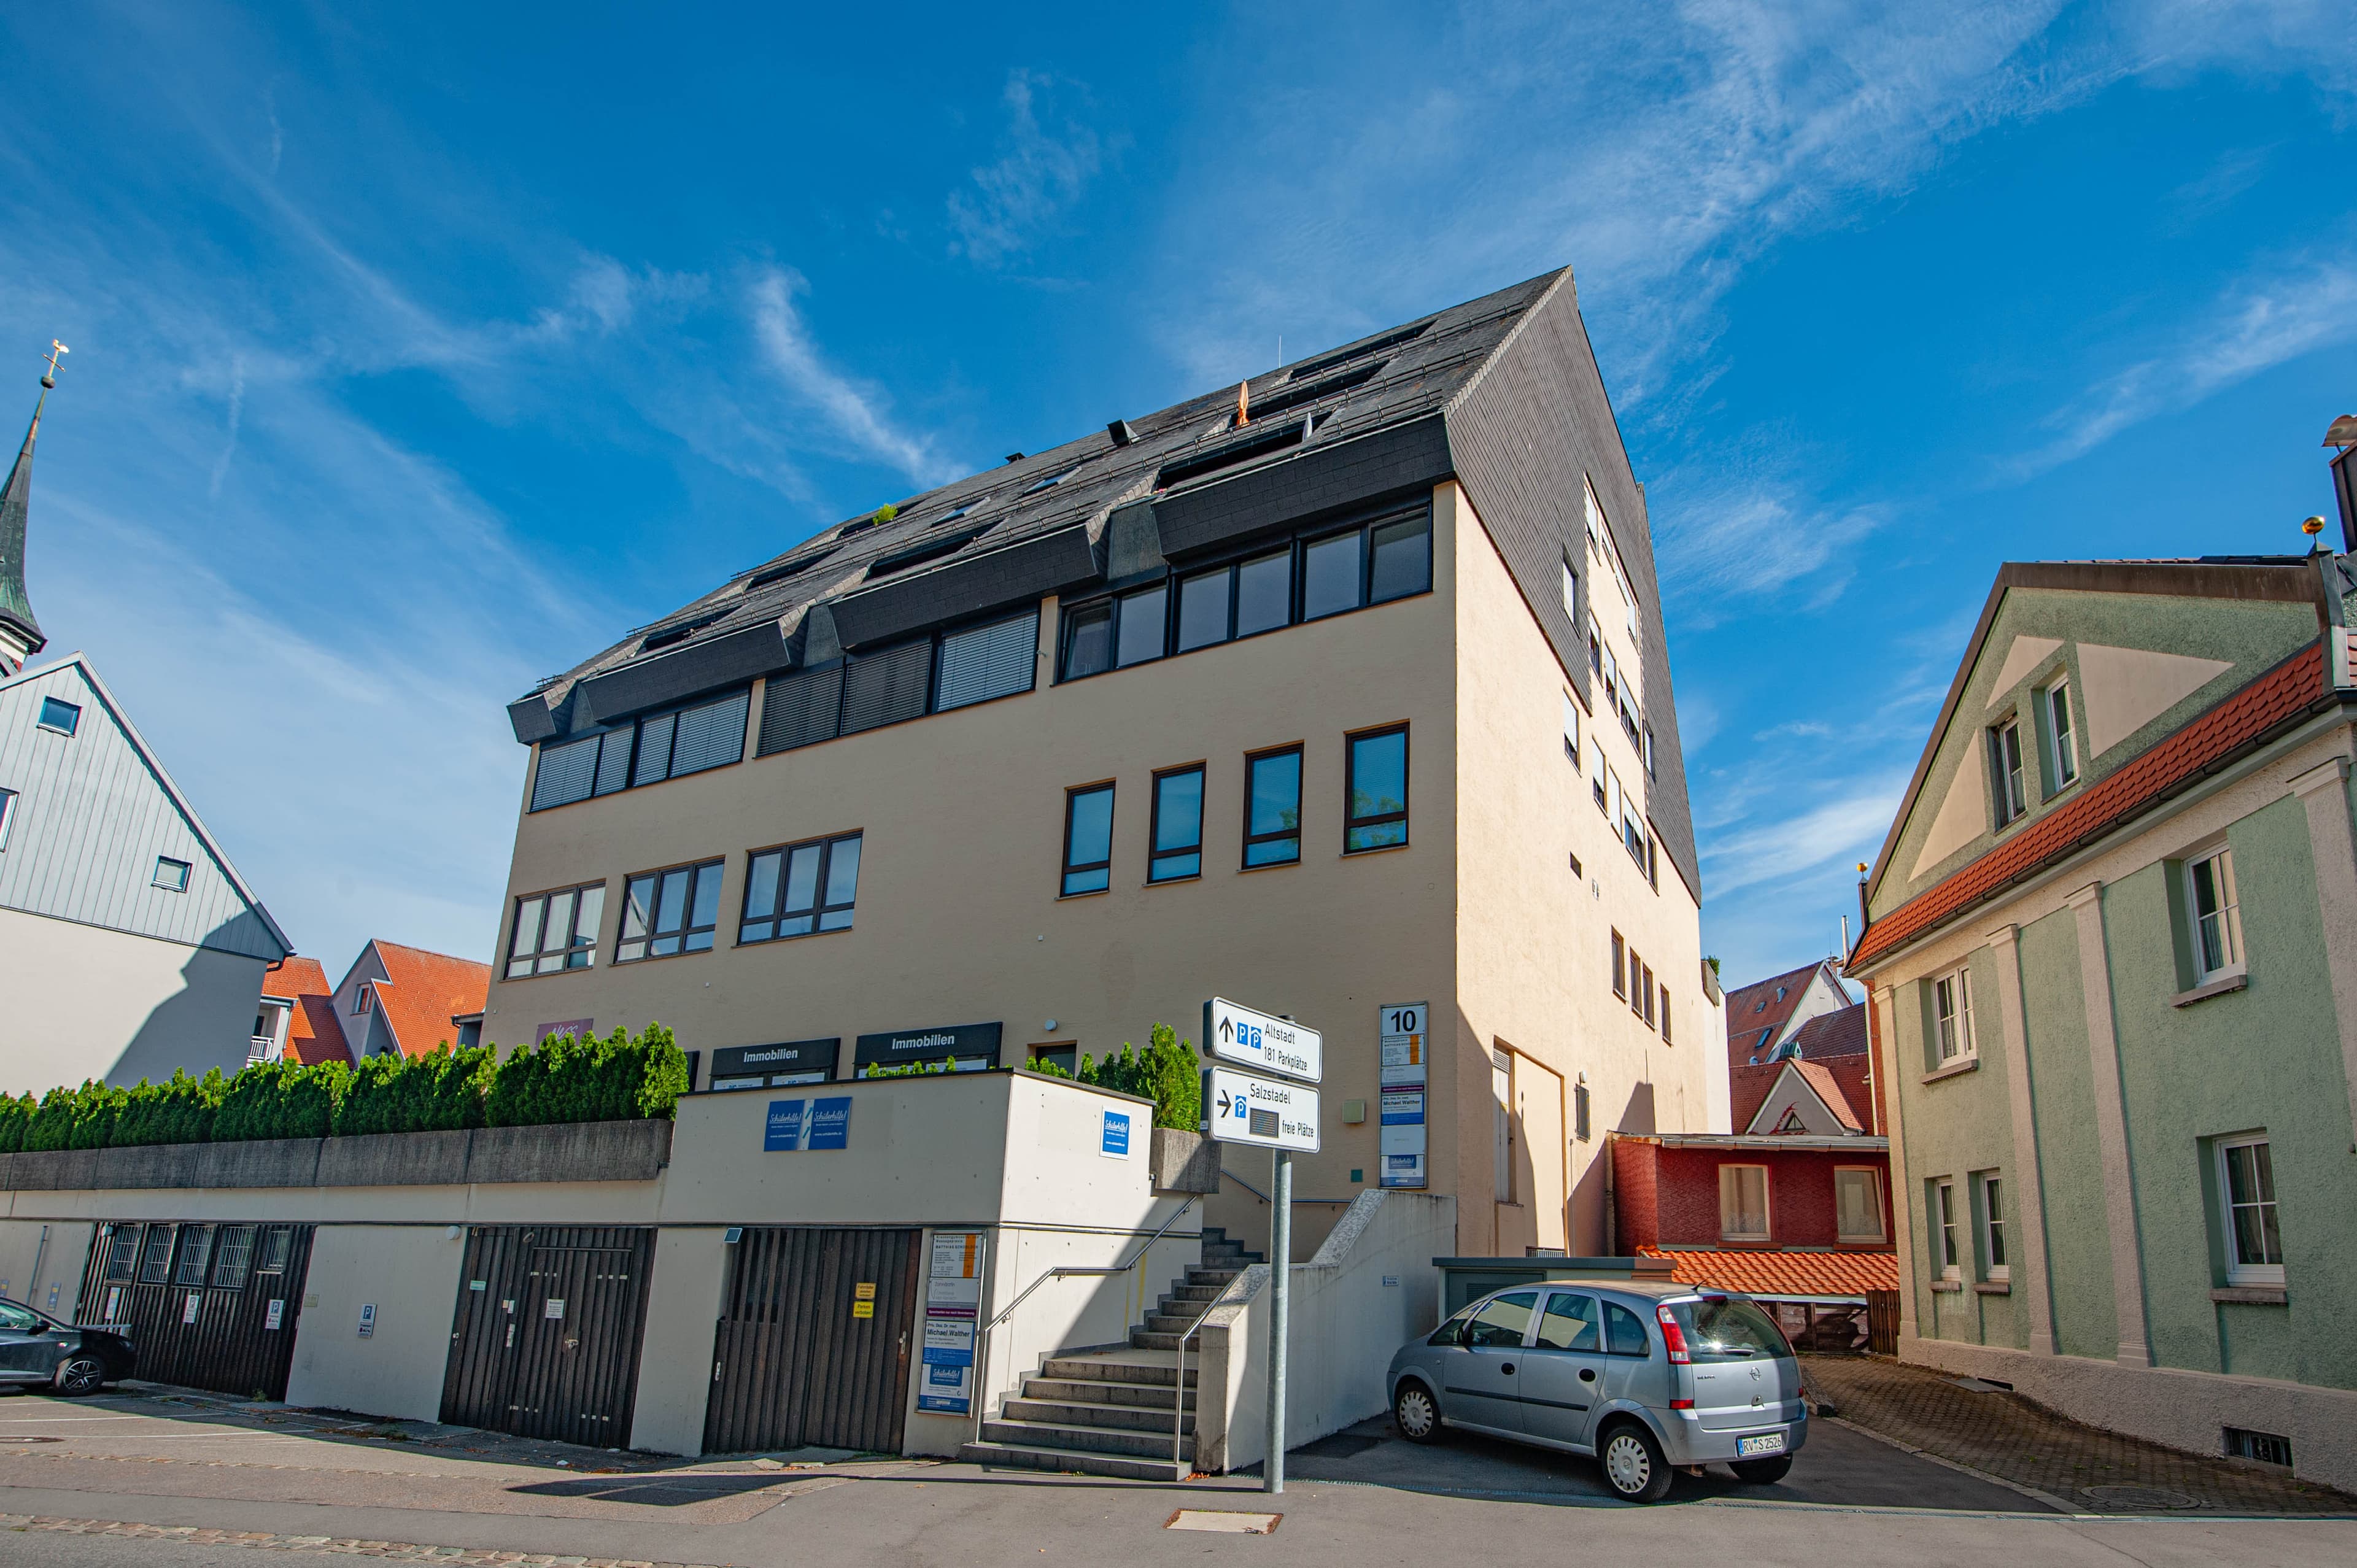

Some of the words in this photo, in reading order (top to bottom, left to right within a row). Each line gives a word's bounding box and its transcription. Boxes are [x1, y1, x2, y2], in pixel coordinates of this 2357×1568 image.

[1391, 1010, 1416, 1032] 10
[892, 1033, 955, 1050] Immobilien
[1264, 1023, 1295, 1045] Altstadt
[743, 1048, 798, 1063] Immobilien
[1264, 1046, 1275, 1062] 181
[1278, 1050, 1307, 1072] Parkplätze
[1250, 1083, 1291, 1105] Salzstadel
[769, 1113, 802, 1124] Schülerhilfe!
[814, 1110, 847, 1122] Schülerhilfe!
[1282, 1120, 1295, 1135] freie
[1298, 1122, 1314, 1137] Plätze
[1743, 1439, 1753, 1453] RV
[1758, 1439, 1763, 1450] S
[1764, 1436, 1781, 1449] 2526
